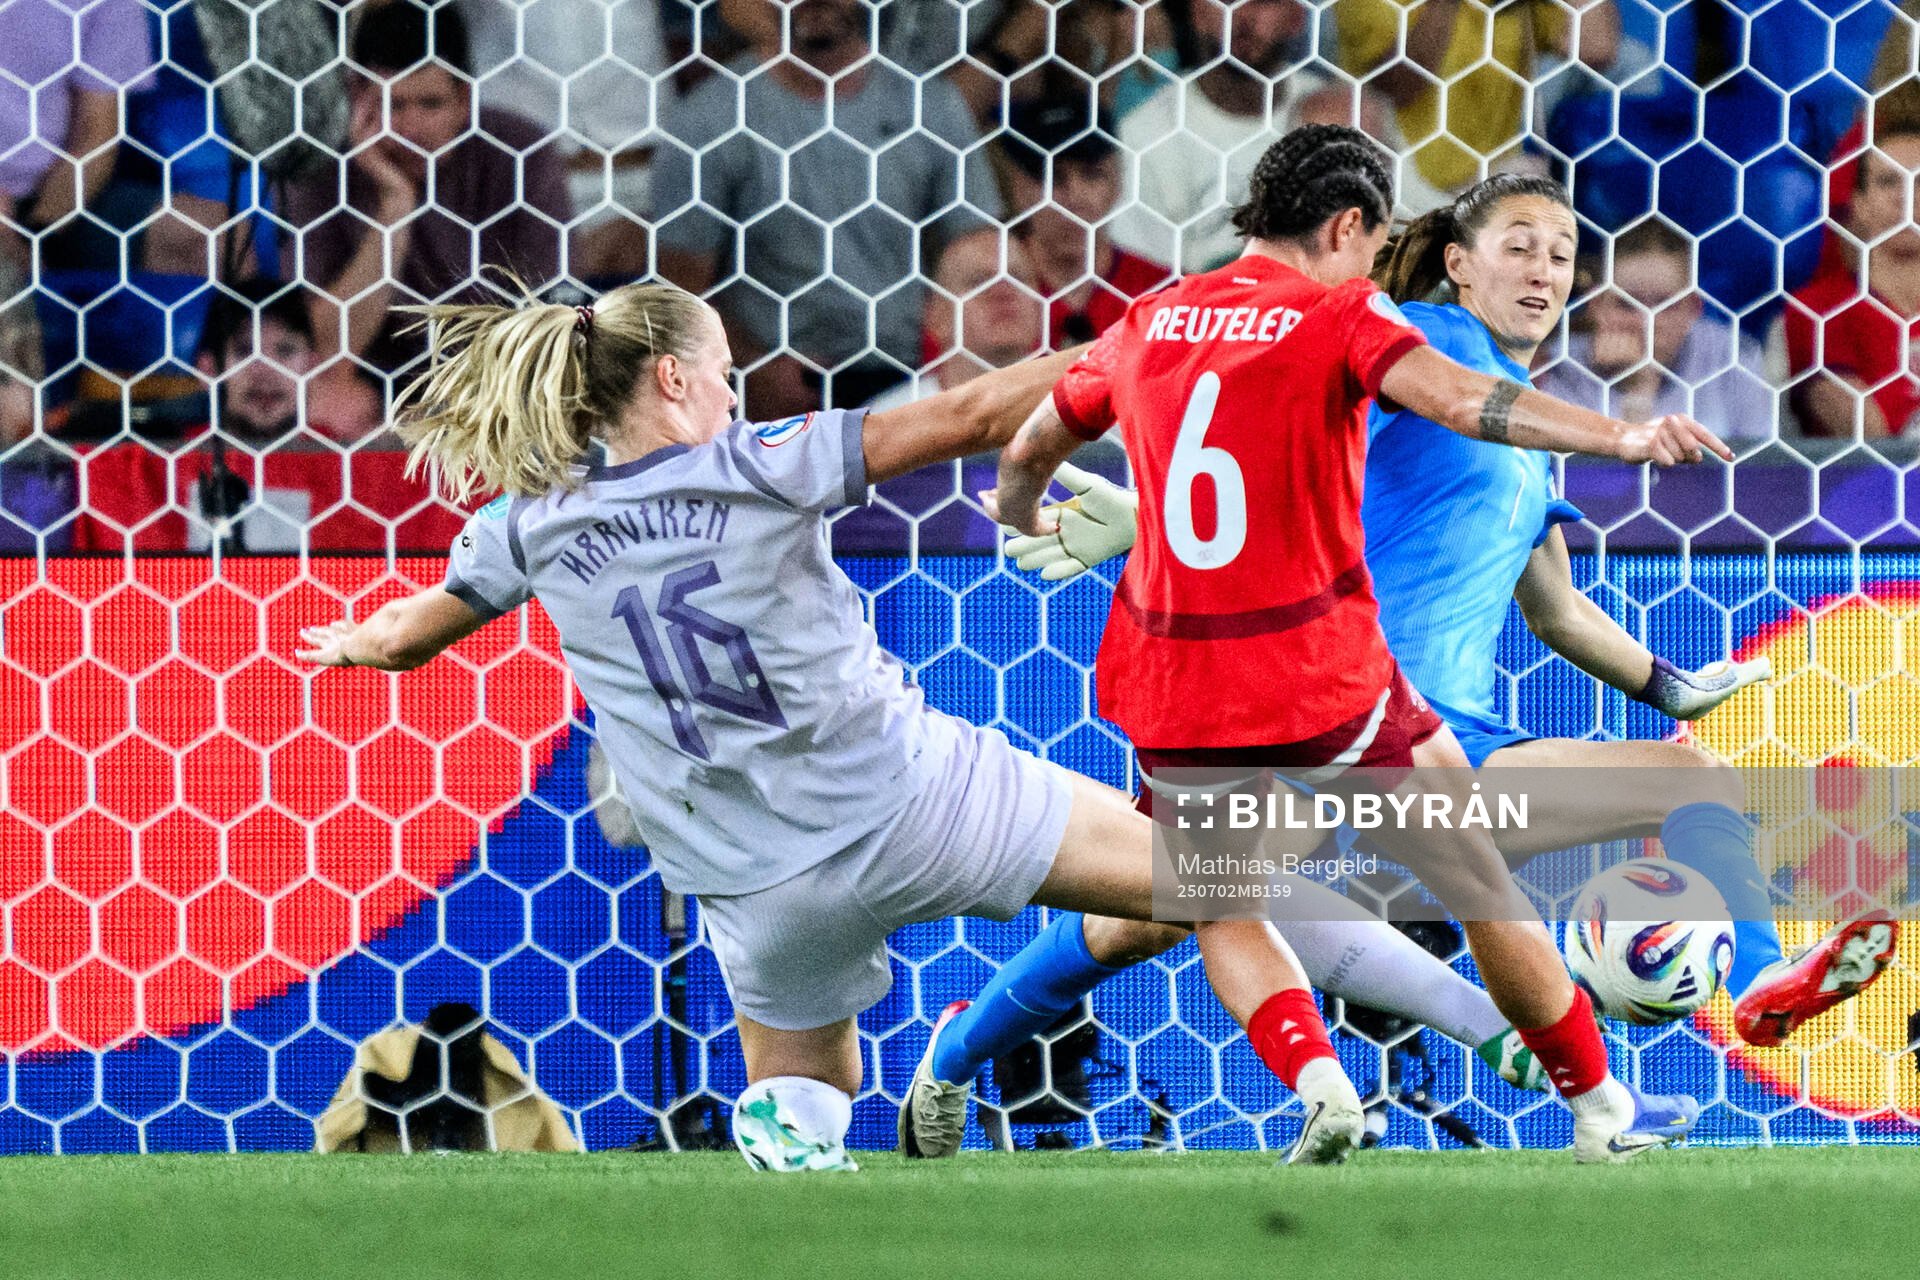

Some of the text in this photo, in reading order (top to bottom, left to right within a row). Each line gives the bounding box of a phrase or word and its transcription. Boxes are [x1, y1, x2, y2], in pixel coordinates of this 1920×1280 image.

[559, 498, 731, 585] HARVIKEN
[1163, 370, 1248, 570] 6
[610, 560, 789, 763] 16
